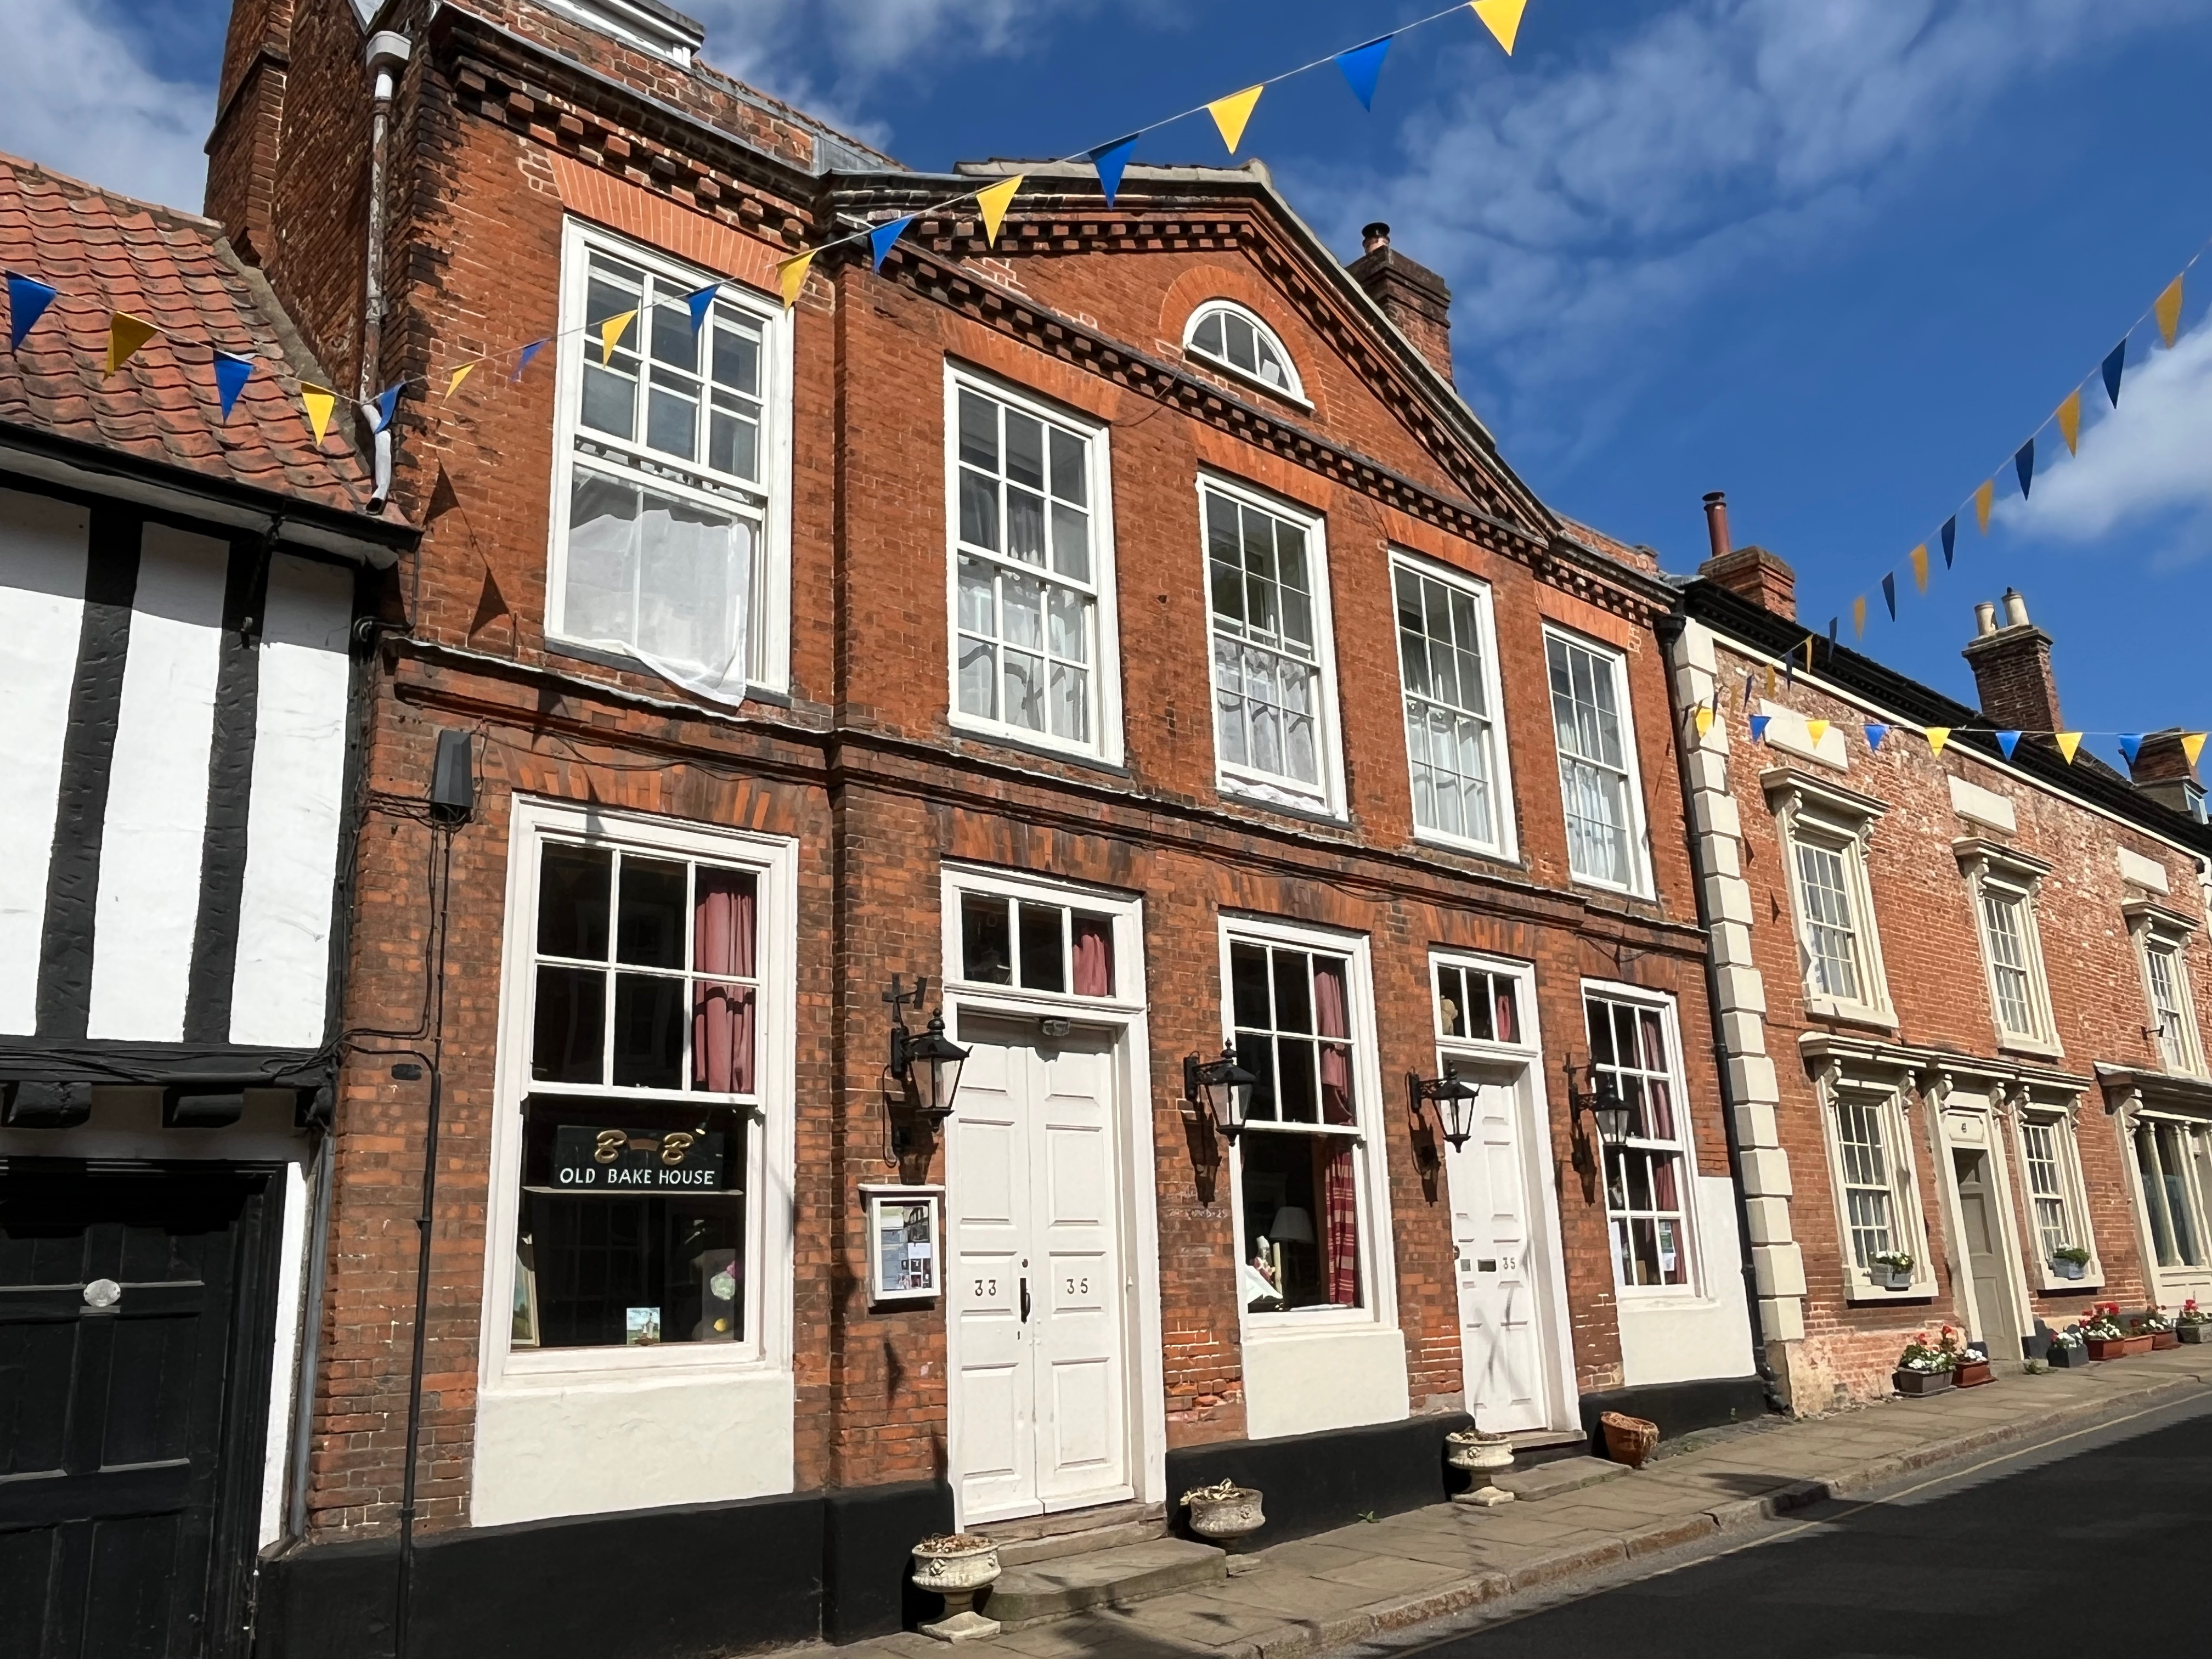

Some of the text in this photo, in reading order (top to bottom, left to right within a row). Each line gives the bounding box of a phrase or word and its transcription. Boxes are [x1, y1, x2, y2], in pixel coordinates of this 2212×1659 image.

[560, 1167, 715, 1184] OLD BAKE HOUSE
[1503, 1257, 1515, 1270] 35
[974, 1279, 996, 1296] 33
[1066, 1278, 1088, 1294] 35
